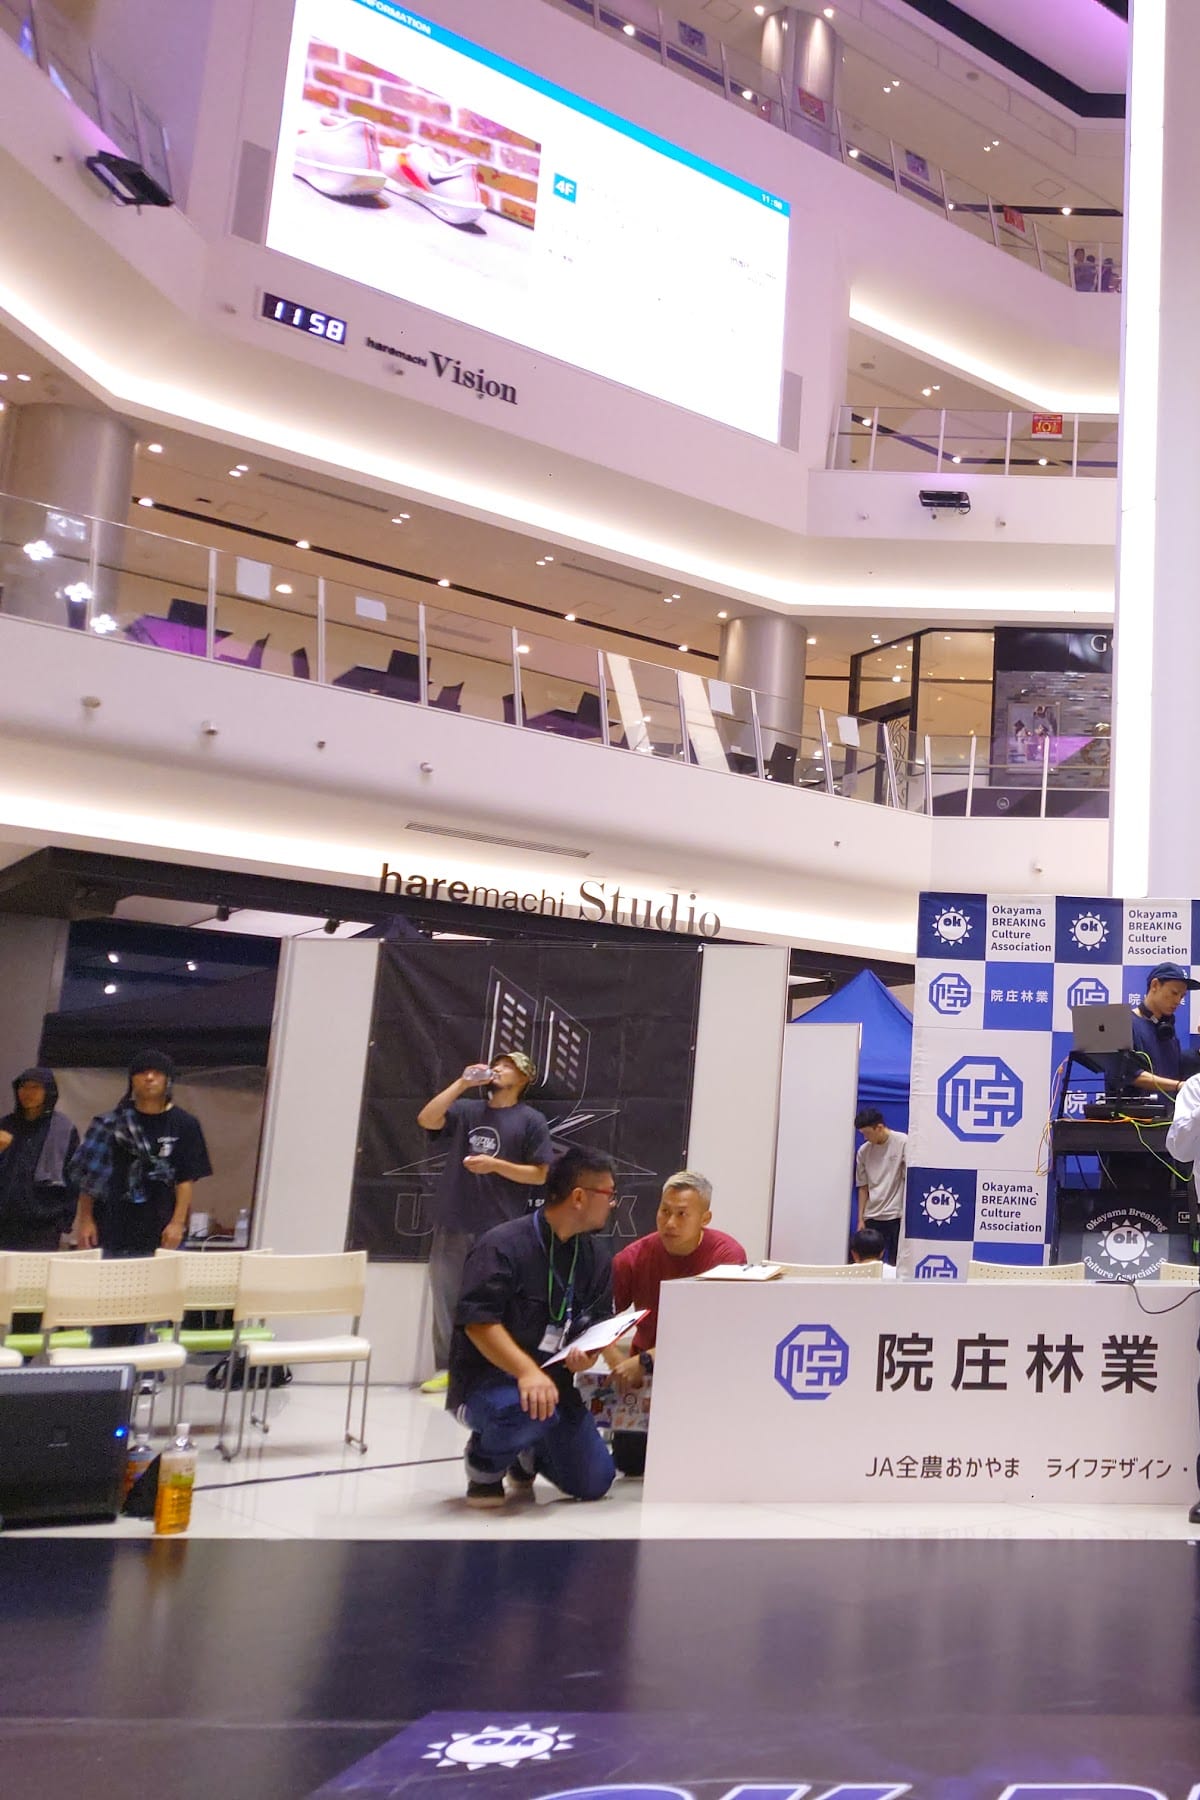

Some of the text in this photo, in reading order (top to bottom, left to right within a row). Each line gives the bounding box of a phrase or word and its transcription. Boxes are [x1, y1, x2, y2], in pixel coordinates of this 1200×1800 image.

[555, 180, 575, 196] 4F
[364, 337, 518, 404] haremachi Vision
[380, 863, 721, 937] haremachi Studio
[992, 905, 1042, 917] Okayama
[1128, 910, 1178, 921] Okayama
[943, 916, 961, 927] ok
[992, 918, 1046, 928] BREAKING
[1080, 920, 1098, 932] ok
[1128, 921, 1182, 931] BREAKING
[992, 930, 1031, 939] Culture
[1128, 933, 1167, 943] Culture
[992, 942, 1052, 952] Association
[1128, 945, 1188, 955] Association
[990, 990, 1049, 1004] 院庄林業
[982, 1182, 1033, 1194] Okayama
[931, 1194, 950, 1206] ok
[981, 1195, 1037, 1206] BREAKING
[981, 1208, 1021, 1219] Culture
[1086, 1208, 1168, 1233] Okayama Breaking
[980, 1221, 1042, 1233] Association
[1113, 1231, 1138, 1244] ok
[1083, 1256, 1114, 1280] Culture
[875, 1332, 1159, 1394] 院庄林業
[865, 1455, 1021, 1480] JA全農おかやま
